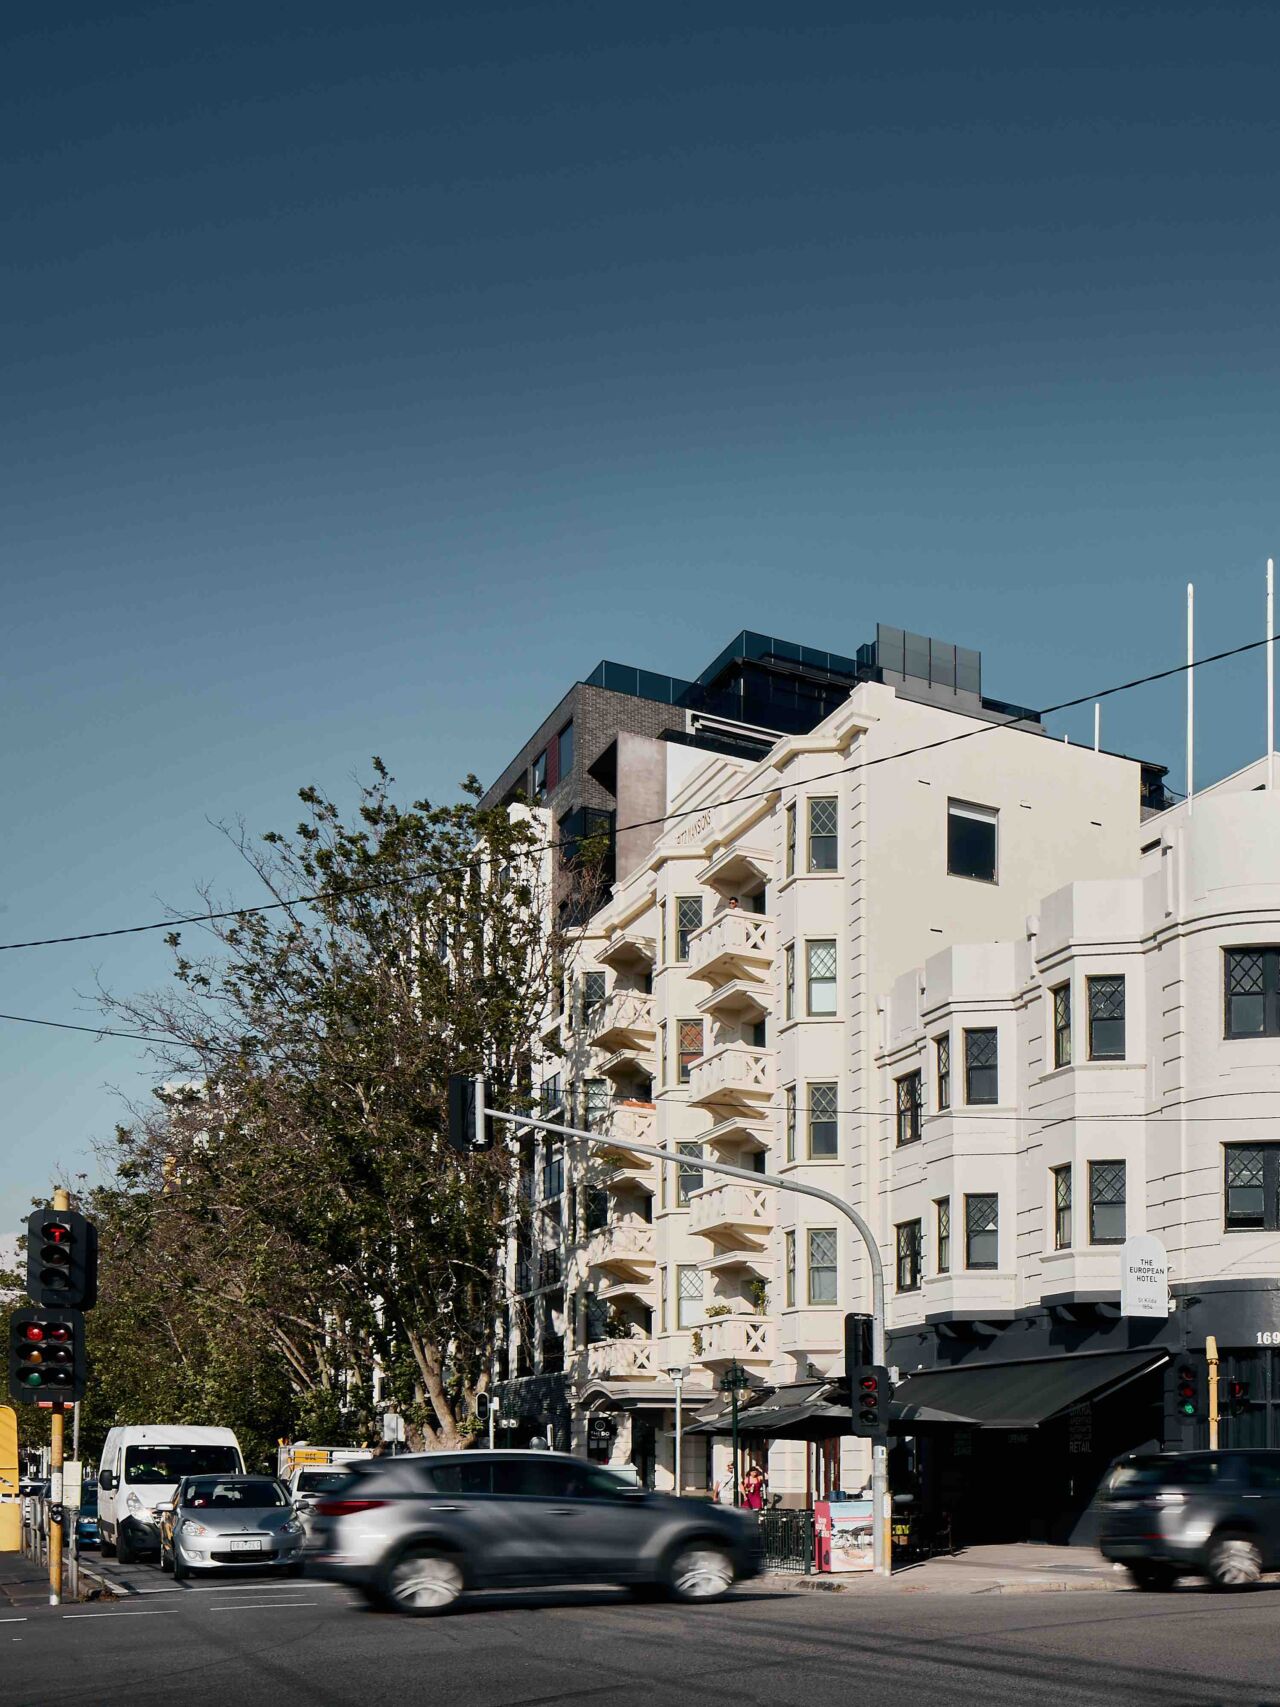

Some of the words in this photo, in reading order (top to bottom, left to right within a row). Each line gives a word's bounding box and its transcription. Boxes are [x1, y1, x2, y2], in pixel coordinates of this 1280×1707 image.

[1140, 1258, 1153, 1266] THE
[1129, 1266, 1165, 1275] EUROPEAN
[1136, 1275, 1158, 1283] HOTEL
[1256, 1331, 1280, 1345] 169
[1069, 1441, 1092, 1453] RETAIL
